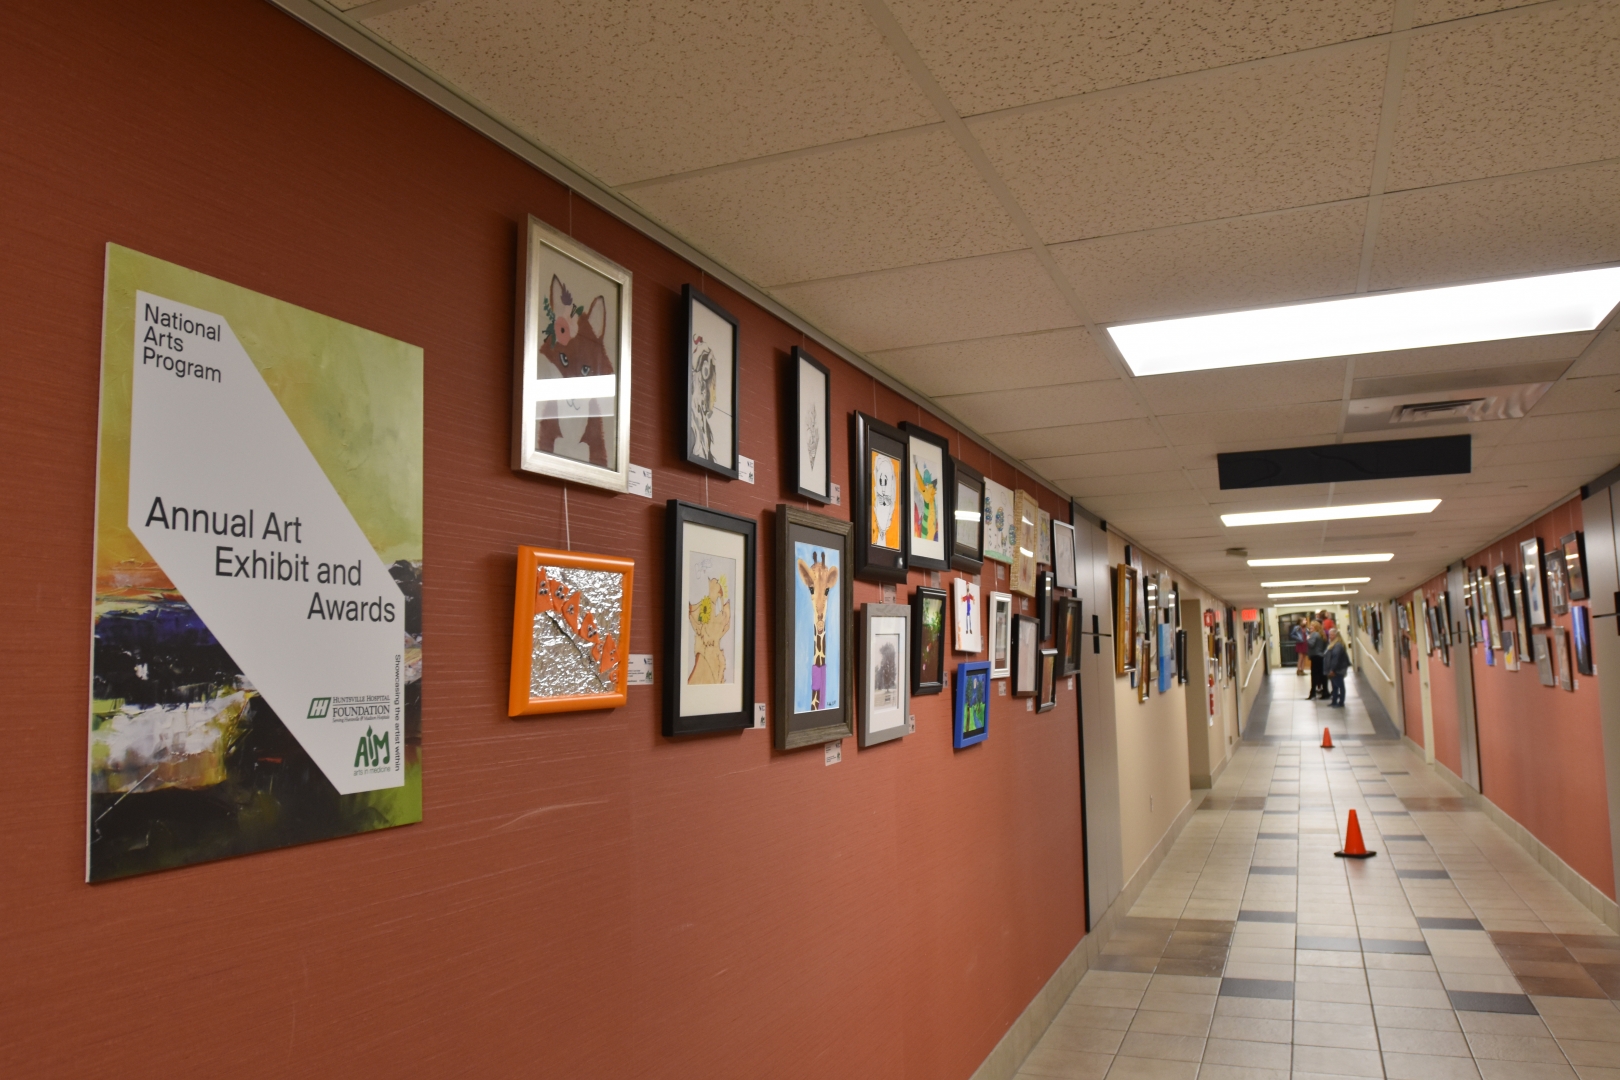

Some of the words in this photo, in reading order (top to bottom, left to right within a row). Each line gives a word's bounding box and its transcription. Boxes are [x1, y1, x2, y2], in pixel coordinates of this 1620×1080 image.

[143, 326, 184, 352] Arts
[144, 303, 221, 342] National
[142, 346, 222, 383] Program
[145, 496, 254, 539] Annual
[262, 512, 302, 544] Art
[215, 546, 309, 582] Exhibit
[317, 559, 362, 586] and
[307, 592, 396, 623] Awards
[333, 705, 390, 717] FOUNDATION
